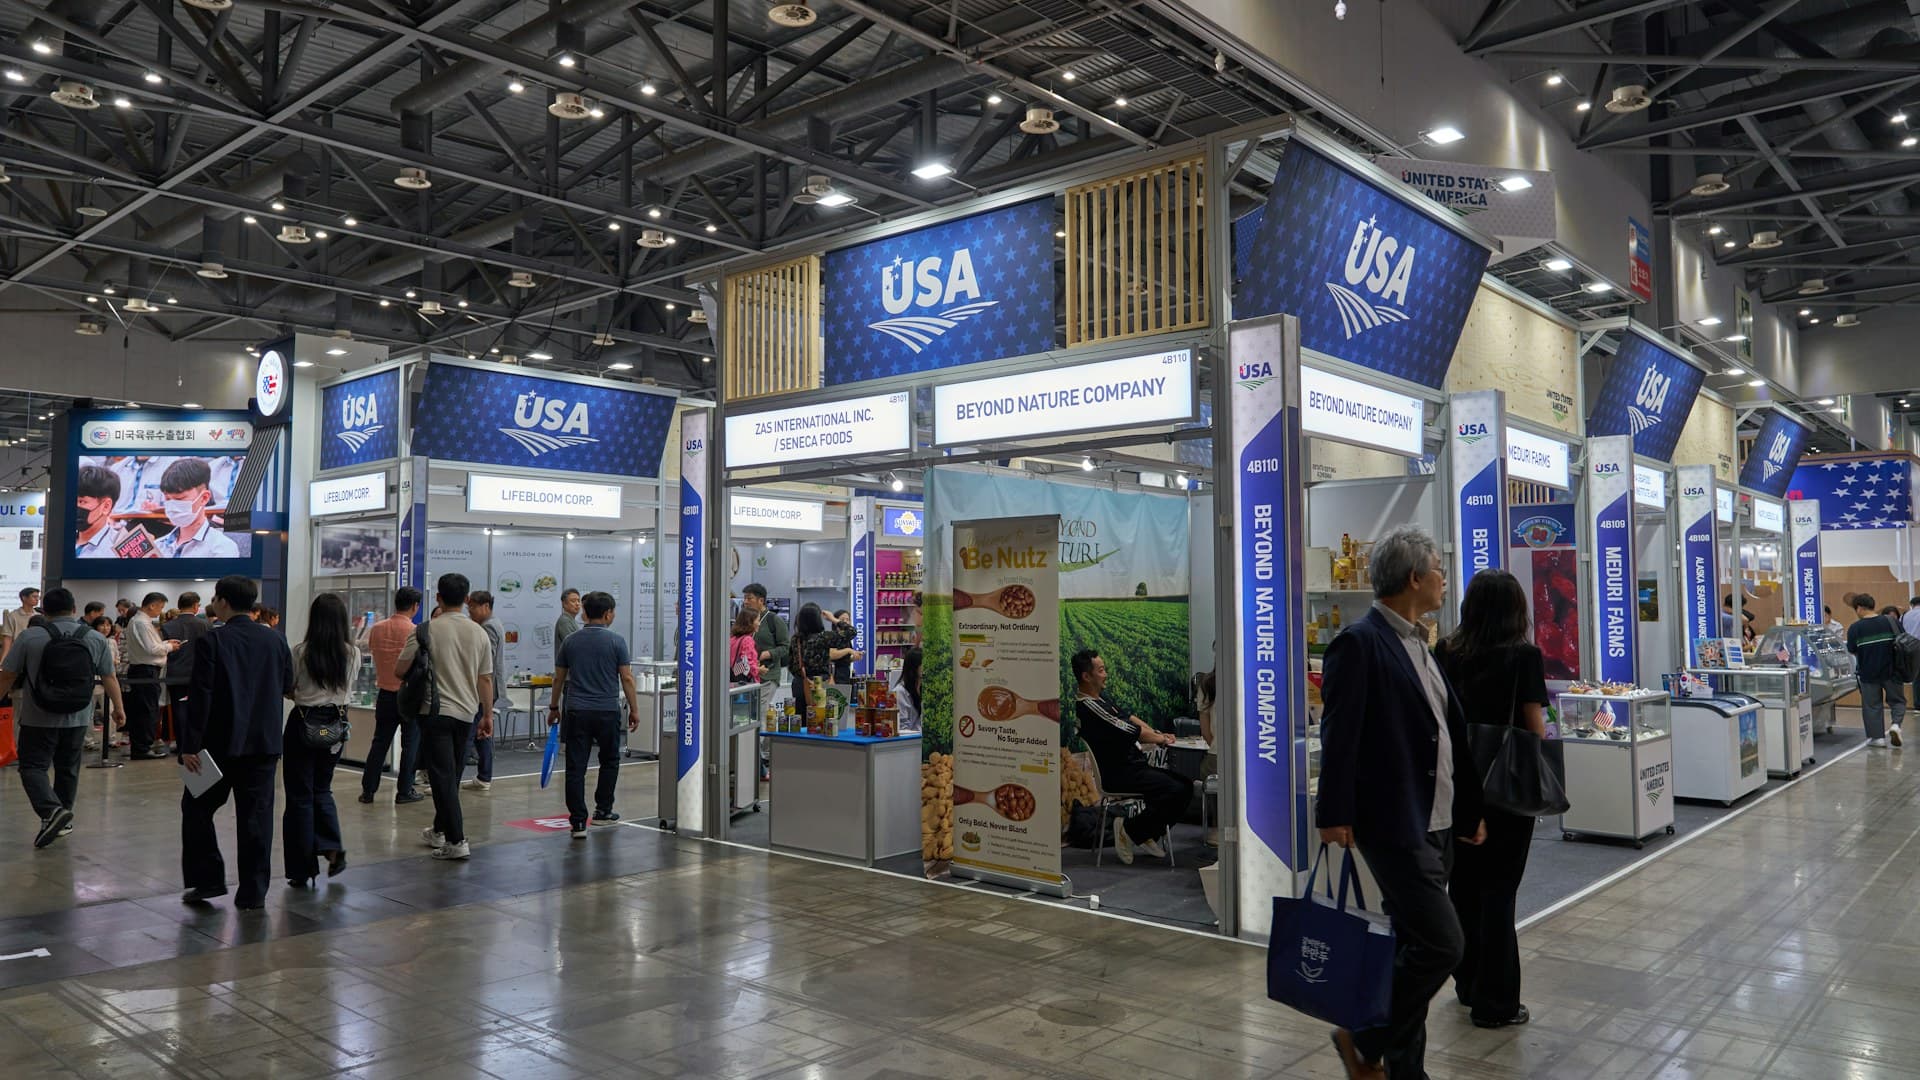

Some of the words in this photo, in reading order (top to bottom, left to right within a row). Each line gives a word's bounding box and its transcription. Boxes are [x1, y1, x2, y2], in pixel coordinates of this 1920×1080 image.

[1402, 169, 1455, 187] UNITED
[1344, 218, 1415, 306] USA
[882, 248, 981, 315] USA
[1162, 353, 1187, 365] 4B110
[1239, 362, 1273, 380] USA
[956, 398, 1015, 420] BEYOND
[1018, 388, 1080, 413] NATURE
[1083, 377, 1166, 405] COMPANY
[1636, 367, 1672, 414] USA
[342, 393, 378, 430] USA
[514, 392, 589, 435] USA
[755, 421, 773, 436] ZAS
[774, 410, 851, 433] INTERNATIONAL
[853, 408, 874, 422] INC.
[1309, 390, 1345, 415] BEYOND
[1345, 399, 1377, 423] NATURE
[1378, 408, 1413, 431] COMPANY
[115, 429, 195, 441] 미국육류수출협회
[820, 430, 853, 447] FOODS
[1458, 423, 1488, 436] USA
[686, 439, 703, 451] USA
[1508, 443, 1531, 463] MEDURI
[1531, 450, 1551, 469] FARMS
[1769, 431, 1791, 465] USA
[1246, 458, 1279, 474] 4B110
[1595, 463, 1620, 473] USA
[324, 490, 354, 504] LIFEBLOOM
[501, 489, 563, 505] LIFEBLOOM
[565, 492, 594, 506] CORP.
[1466, 494, 1493, 506] 4B110
[1683, 486, 1705, 496] USA
[0, 505, 16, 516] UL
[683, 505, 699, 516] 4B101
[733, 505, 779, 519] LIFEBLOOM
[780, 508, 802, 521] CORP.
[1795, 516, 1813, 524] USA
[1059, 519, 1097, 538] YOND
[1600, 519, 1626, 529] 4B109
[685, 536, 694, 557] ZAS
[1059, 541, 1100, 564] TURE
[1254, 503, 1274, 581] BEYOND
[1473, 528, 1490, 573] BEYO
[967, 547, 993, 570] Be
[997, 546, 1048, 569] Nutz
[1695, 556, 1705, 583] ALASKA
[1605, 546, 1623, 602] MEDURI
[1804, 568, 1814, 596] PACIFIC
[684, 560, 694, 637] INTERNATIONAL
[855, 567, 864, 620] LIFEBLOOM
[1696, 585, 1706, 615] SEAFOOD
[958, 622, 999, 632] Extraordinary,
[1000, 623, 1012, 631] Not
[1012, 623, 1040, 632] Ordinary
[1255, 587, 1275, 662] NATURE
[1608, 607, 1626, 658] FARMS
[1698, 616, 1707, 639] MARKE
[856, 622, 864, 651] CORP.
[685, 669, 693, 710] SENECA
[1257, 668, 1277, 764] COMPANY
[684, 712, 693, 746] FOODS
[978, 724, 997, 734] Savory
[998, 726, 1018, 736] Taste,
[997, 734, 1006, 742] No
[1006, 735, 1026, 745] Sugar
[1026, 737, 1048, 746] Added
[1639, 766, 1655, 781] UNITED
[1646, 775, 1665, 792] AMERICA
[958, 816, 972, 827] Only
[989, 821, 1007, 831] Never
